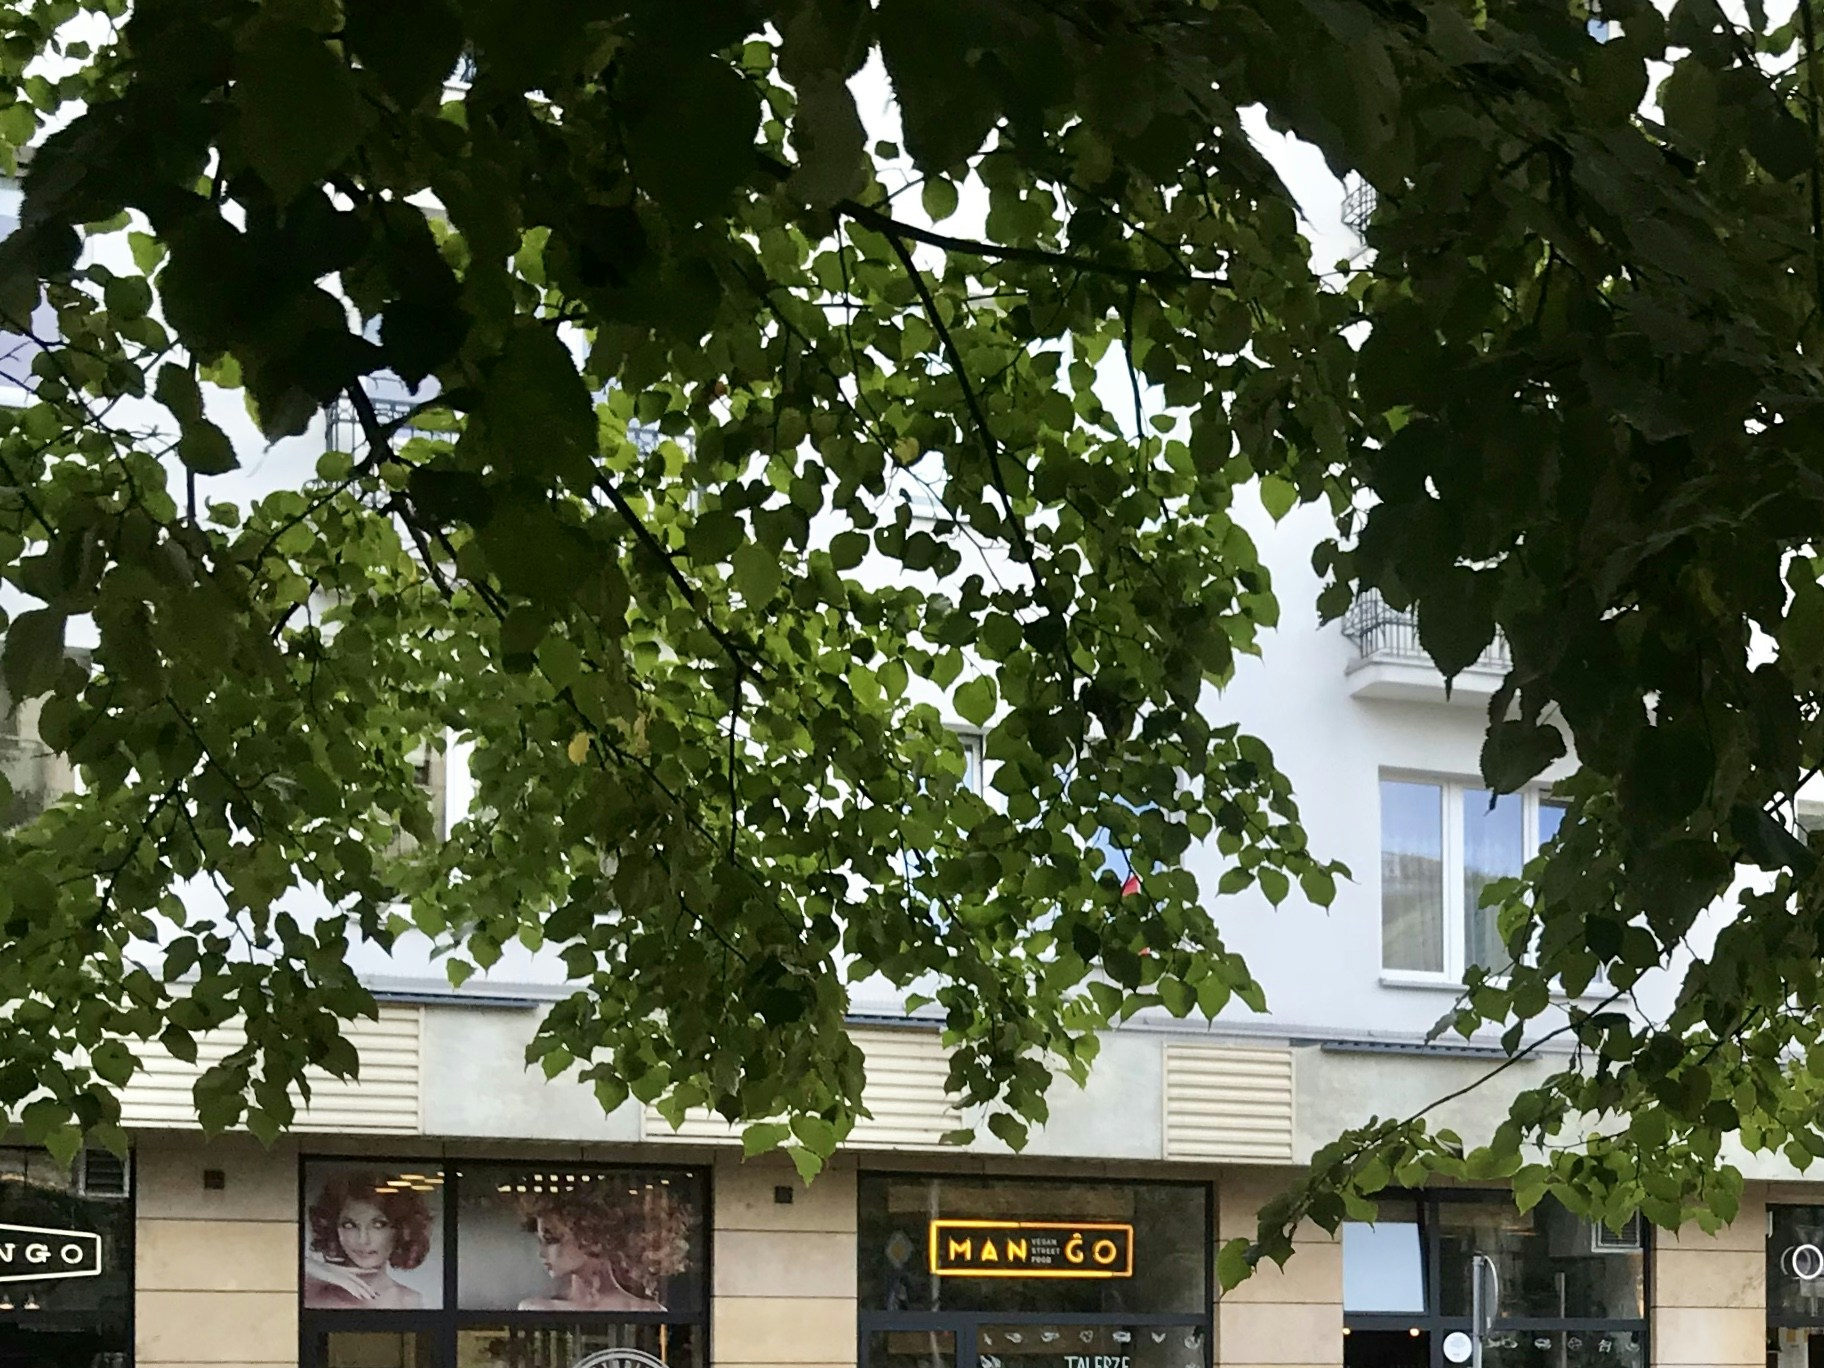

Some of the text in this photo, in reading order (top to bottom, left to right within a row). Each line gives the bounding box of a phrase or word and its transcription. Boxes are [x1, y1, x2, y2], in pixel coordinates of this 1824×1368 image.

[1031, 1238, 1057, 1246] VEGAN
[949, 1237, 1027, 1262] MAN
[1031, 1247, 1060, 1255] STREET
[1031, 1255, 1052, 1264] FOOD
